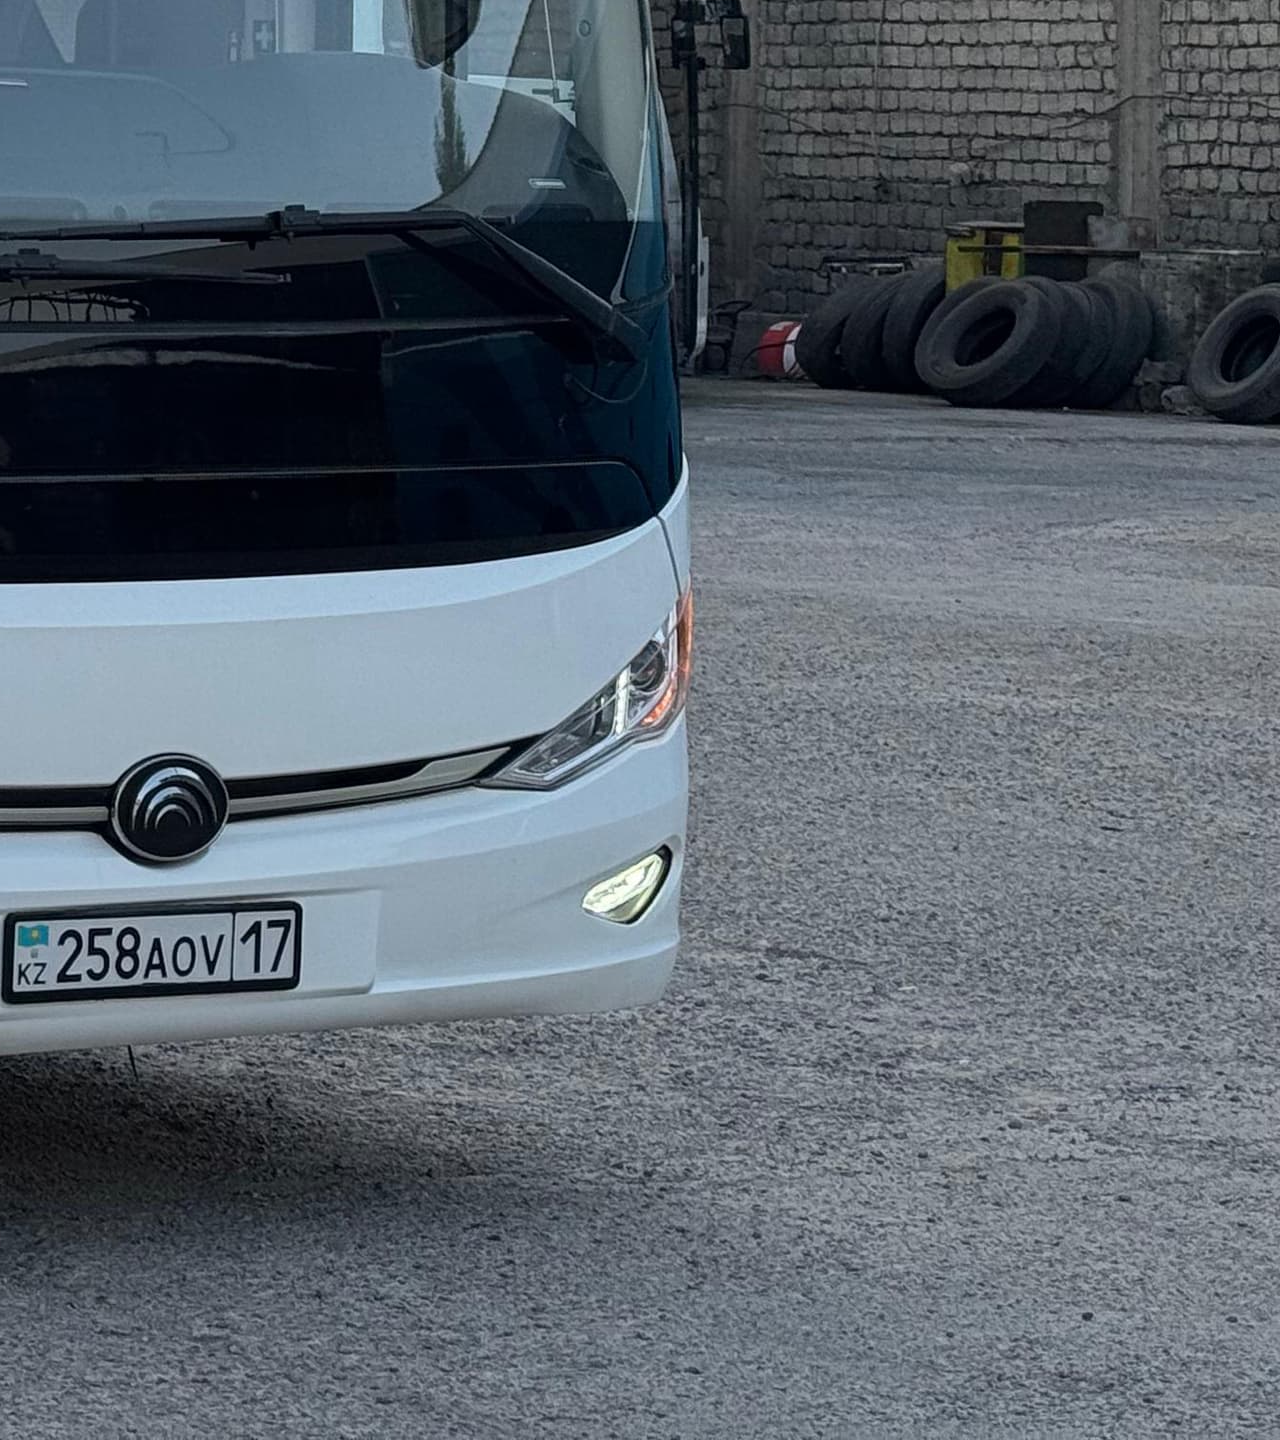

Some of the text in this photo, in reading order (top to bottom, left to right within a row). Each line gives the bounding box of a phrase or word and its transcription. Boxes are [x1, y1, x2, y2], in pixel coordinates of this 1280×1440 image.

[55, 918, 293, 983] 258AOV 17
[17, 963, 47, 986] KZ
